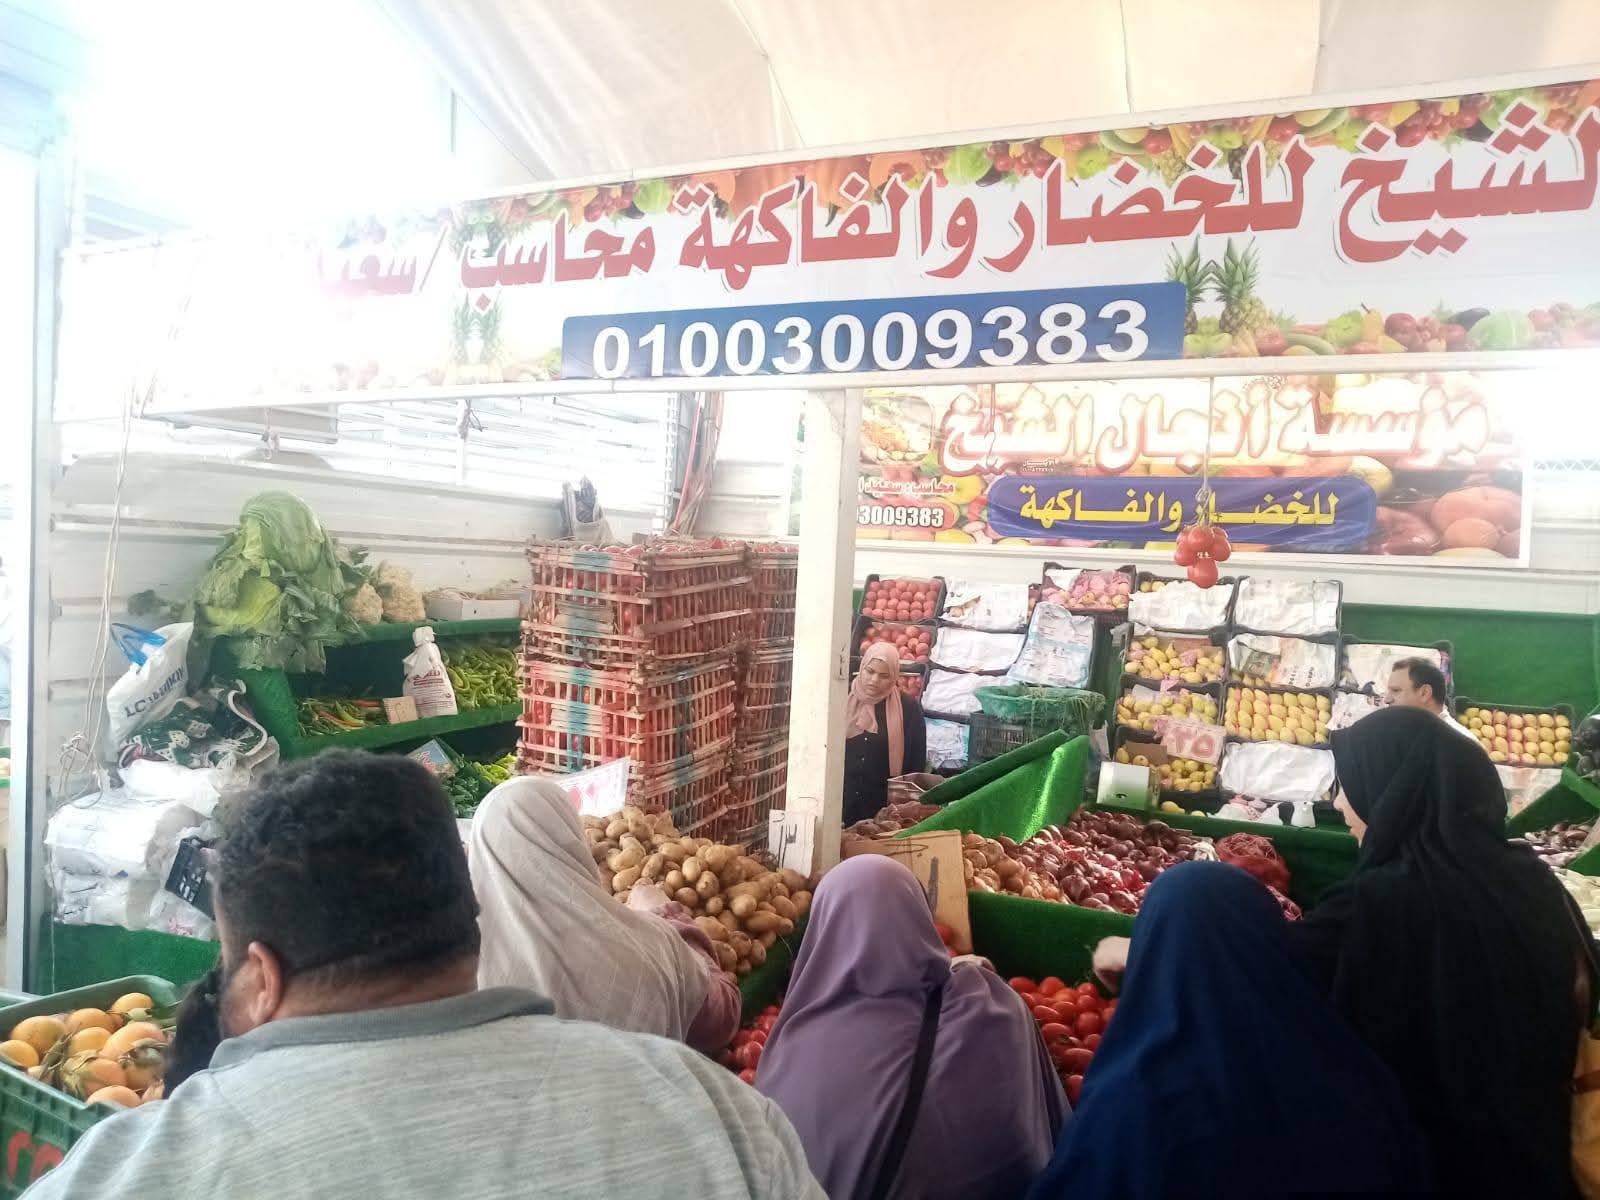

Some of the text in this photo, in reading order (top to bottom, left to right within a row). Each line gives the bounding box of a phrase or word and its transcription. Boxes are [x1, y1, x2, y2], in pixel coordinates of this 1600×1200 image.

[676, 170, 979, 291] والفاكهة
[984, 139, 1315, 273] للخضار
[460, 209, 656, 313] محاسب
[592, 300, 1149, 379] 01003009383
[939, 384, 1095, 475] الشيخ
[856, 504, 945, 528] 3009383
[1019, 485, 1184, 533] والفاكهة
